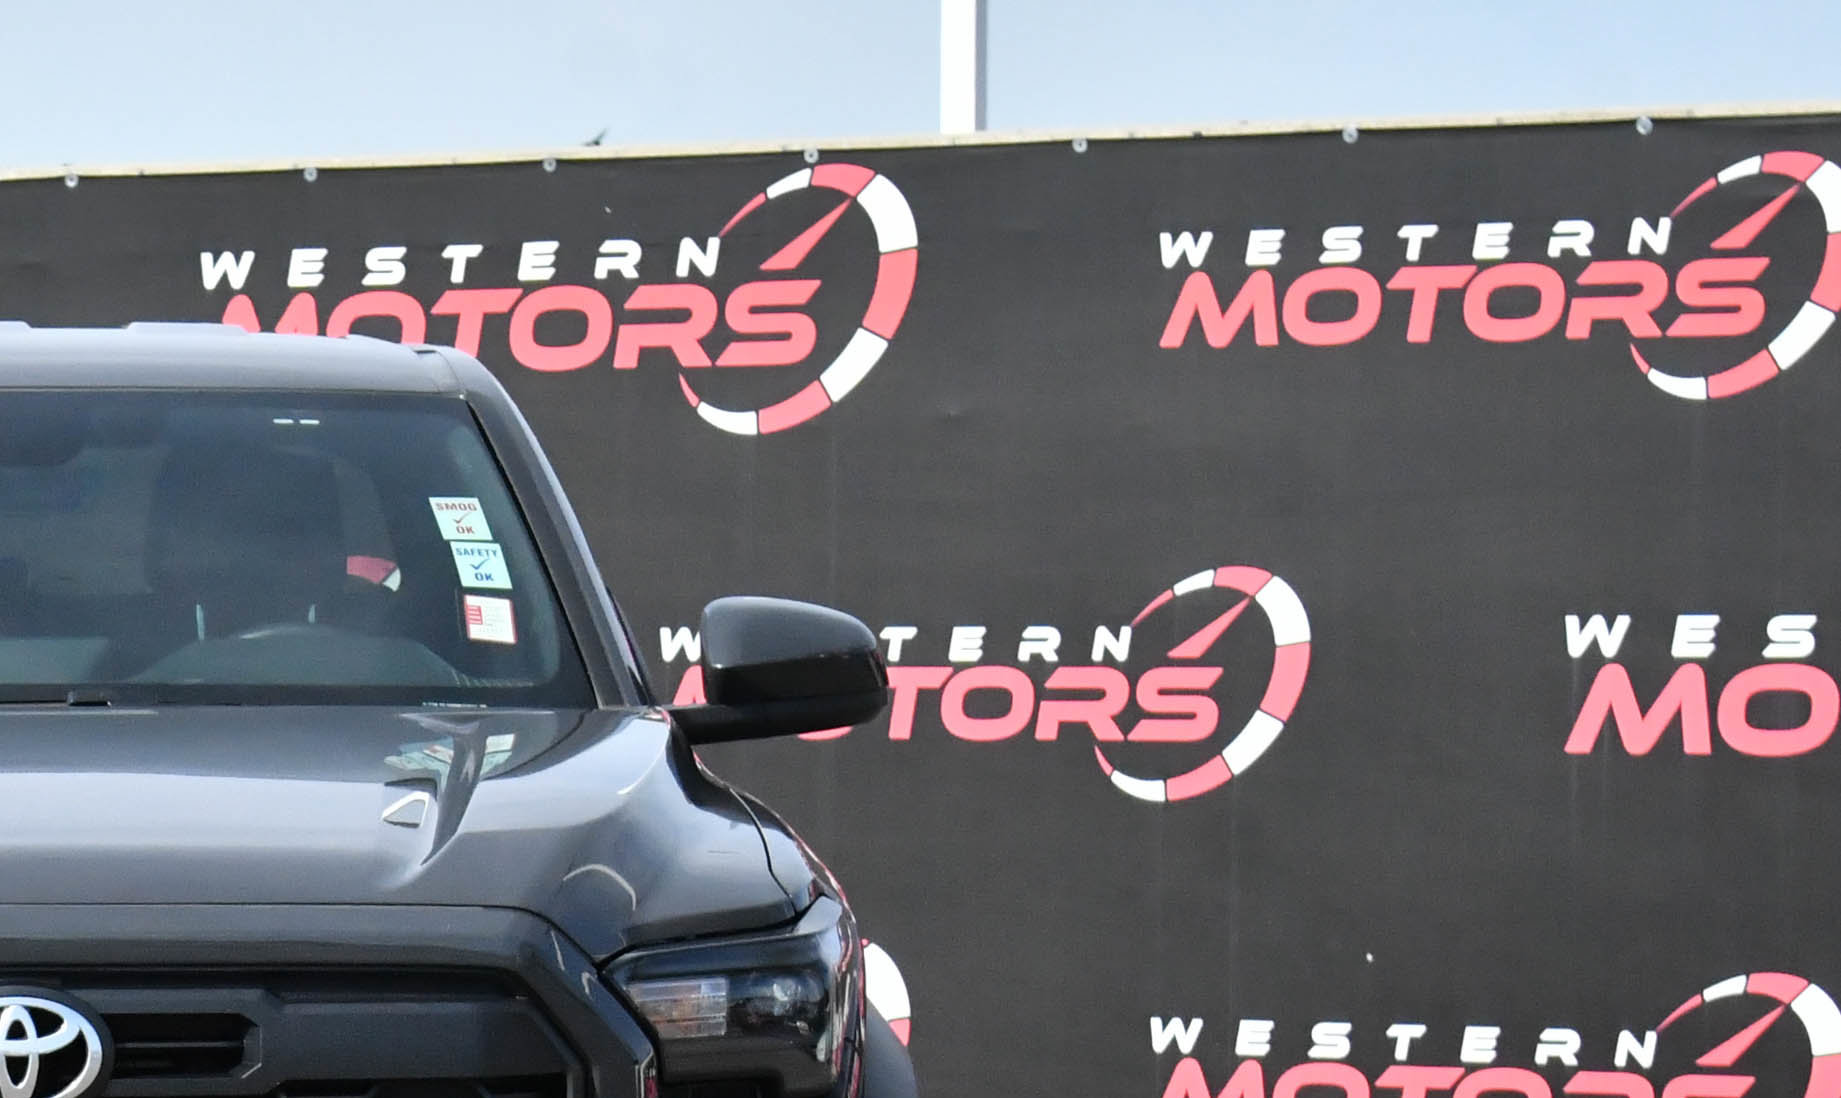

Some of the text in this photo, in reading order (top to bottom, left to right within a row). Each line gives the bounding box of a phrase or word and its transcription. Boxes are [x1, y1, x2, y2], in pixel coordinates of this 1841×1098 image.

[200, 237, 720, 290] WESTERN
[1159, 217, 1672, 269] WESTERN
[1159, 256, 1771, 349] MOTORS
[435, 501, 478, 513] SMOG
[456, 525, 476, 535] OK
[455, 547, 499, 558] SAFETY
[474, 572, 495, 582] OK
[1564, 613, 1818, 659] WES
[1563, 662, 1841, 758] MO
[1149, 1016, 1657, 1069] WESTERN
